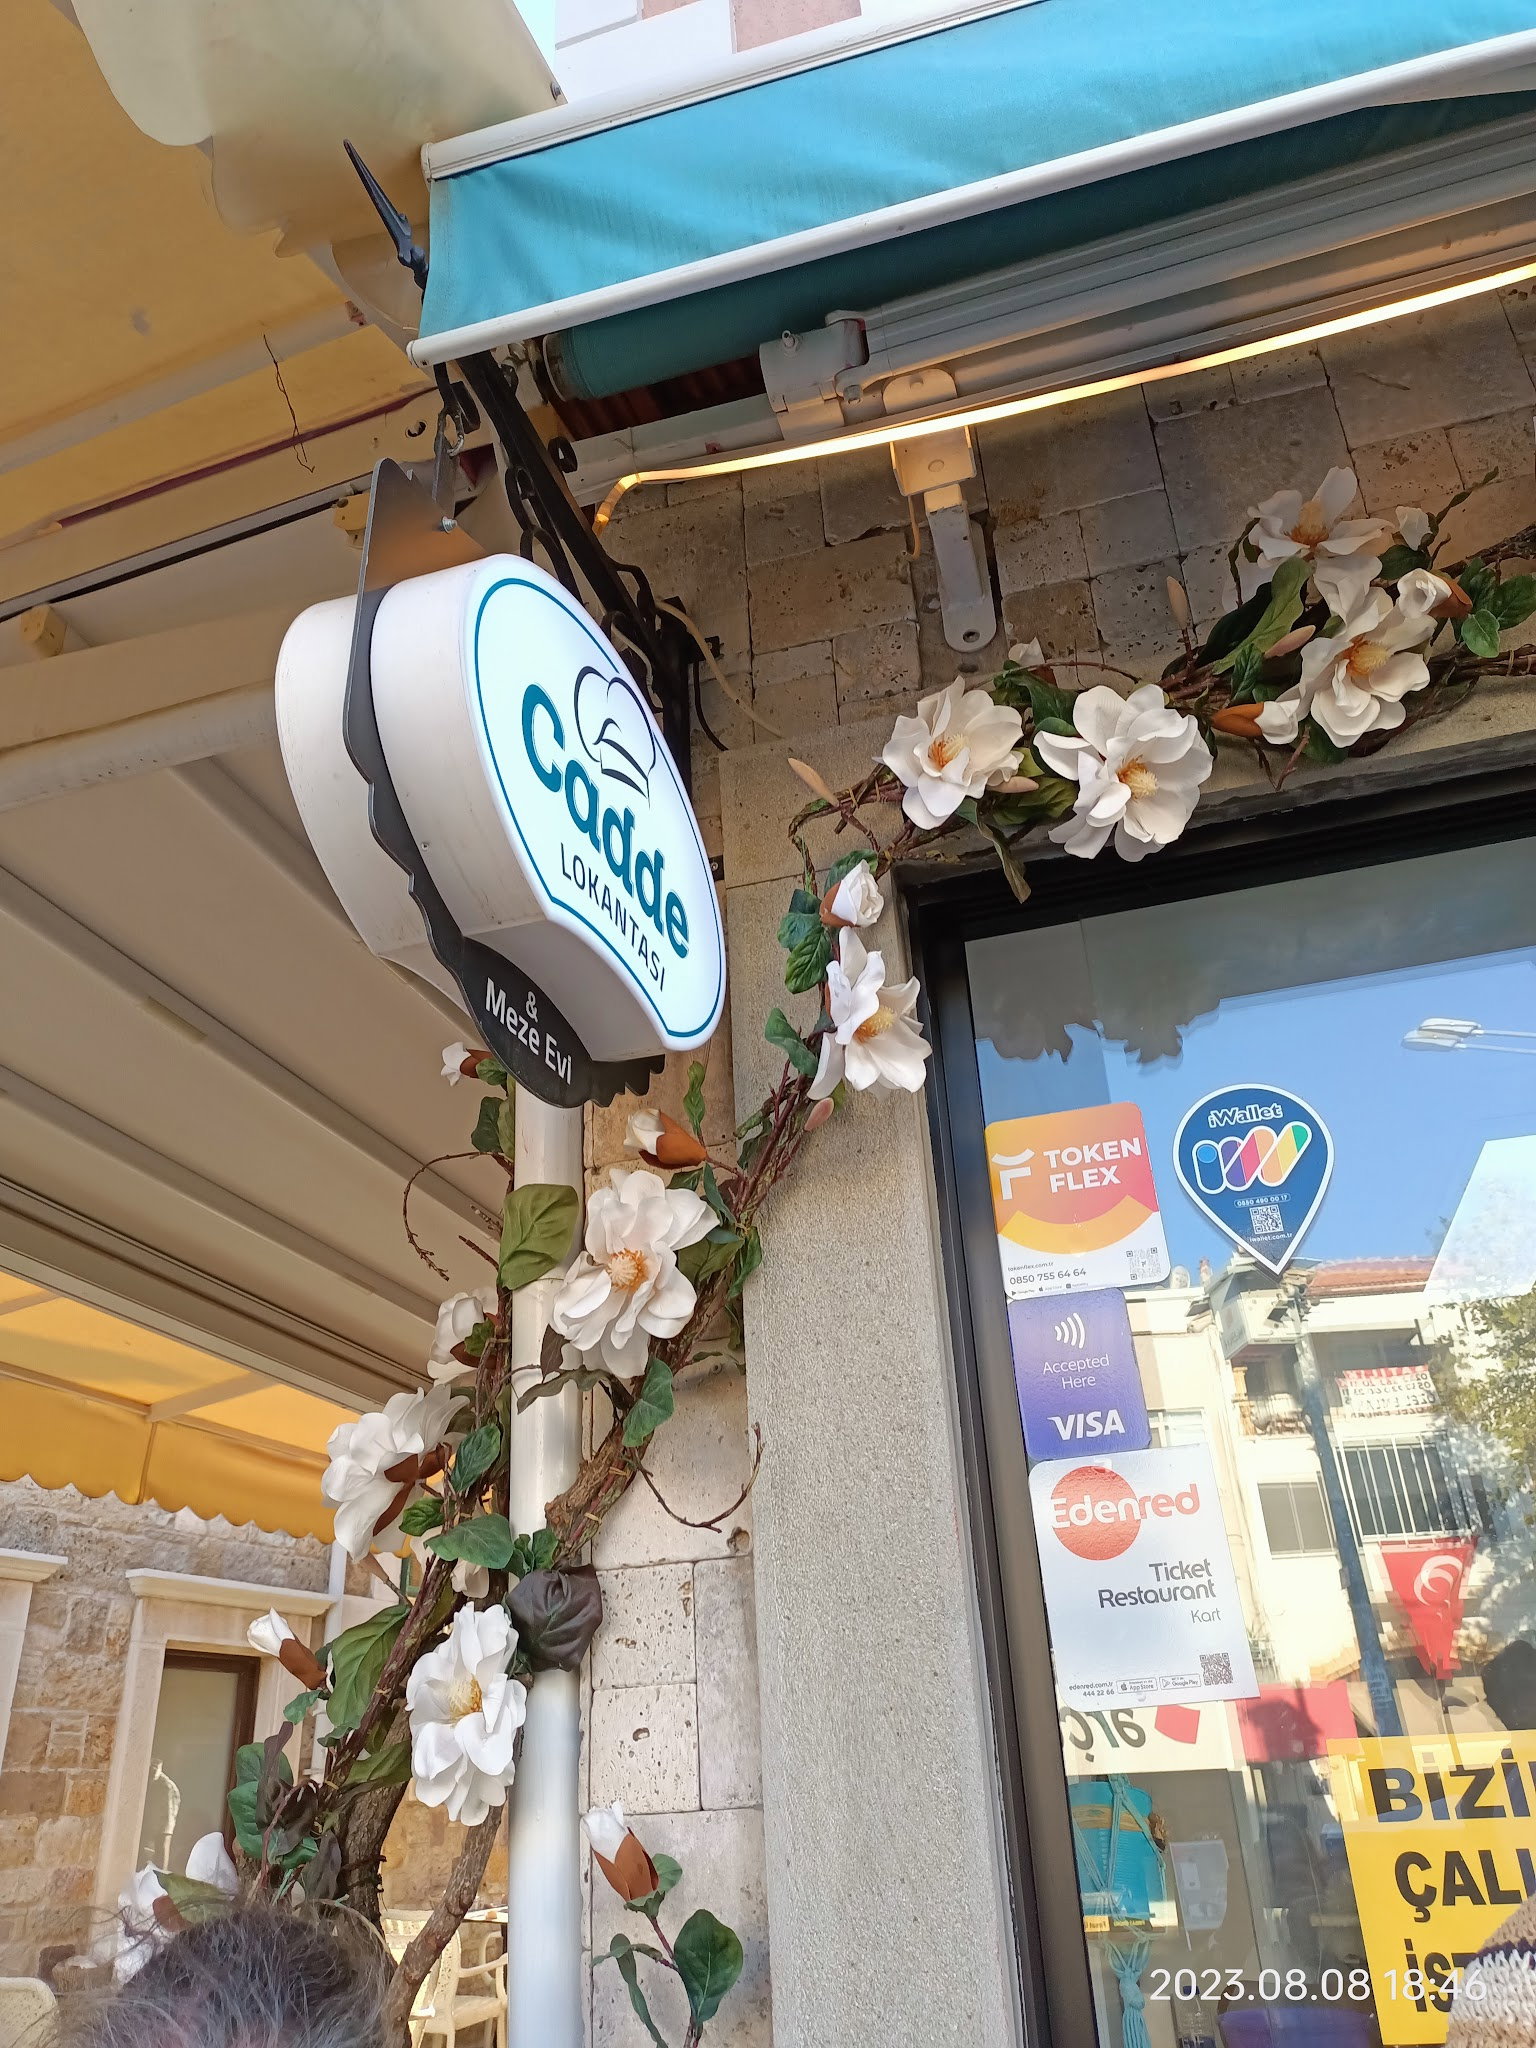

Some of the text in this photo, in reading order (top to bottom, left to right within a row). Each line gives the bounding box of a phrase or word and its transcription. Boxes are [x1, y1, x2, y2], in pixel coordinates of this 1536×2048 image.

[521, 683, 689, 959] Cadde
[561, 842, 665, 992] LOKANTASI
[525, 990, 539, 1023] &
[485, 976, 572, 1085] Meze Evi
[1208, 1102, 1283, 1128] iWallet
[1043, 1136, 1142, 1168] TOKEN
[1049, 1165, 1122, 1194] FLEX
[1009, 1268, 1087, 1285] 0850 755 64 64
[1043, 1353, 1110, 1375] Accepted
[1061, 1375, 1097, 1390] Here
[1047, 1408, 1126, 1441] VISA
[1051, 1483, 1201, 1529] Edenred
[1149, 1558, 1213, 1582] Ticket
[1098, 1579, 1217, 1609] Restaurant
[1190, 1607, 1222, 1624] Kart
[1069, 1682, 1113, 1691] edenred.com.tr
